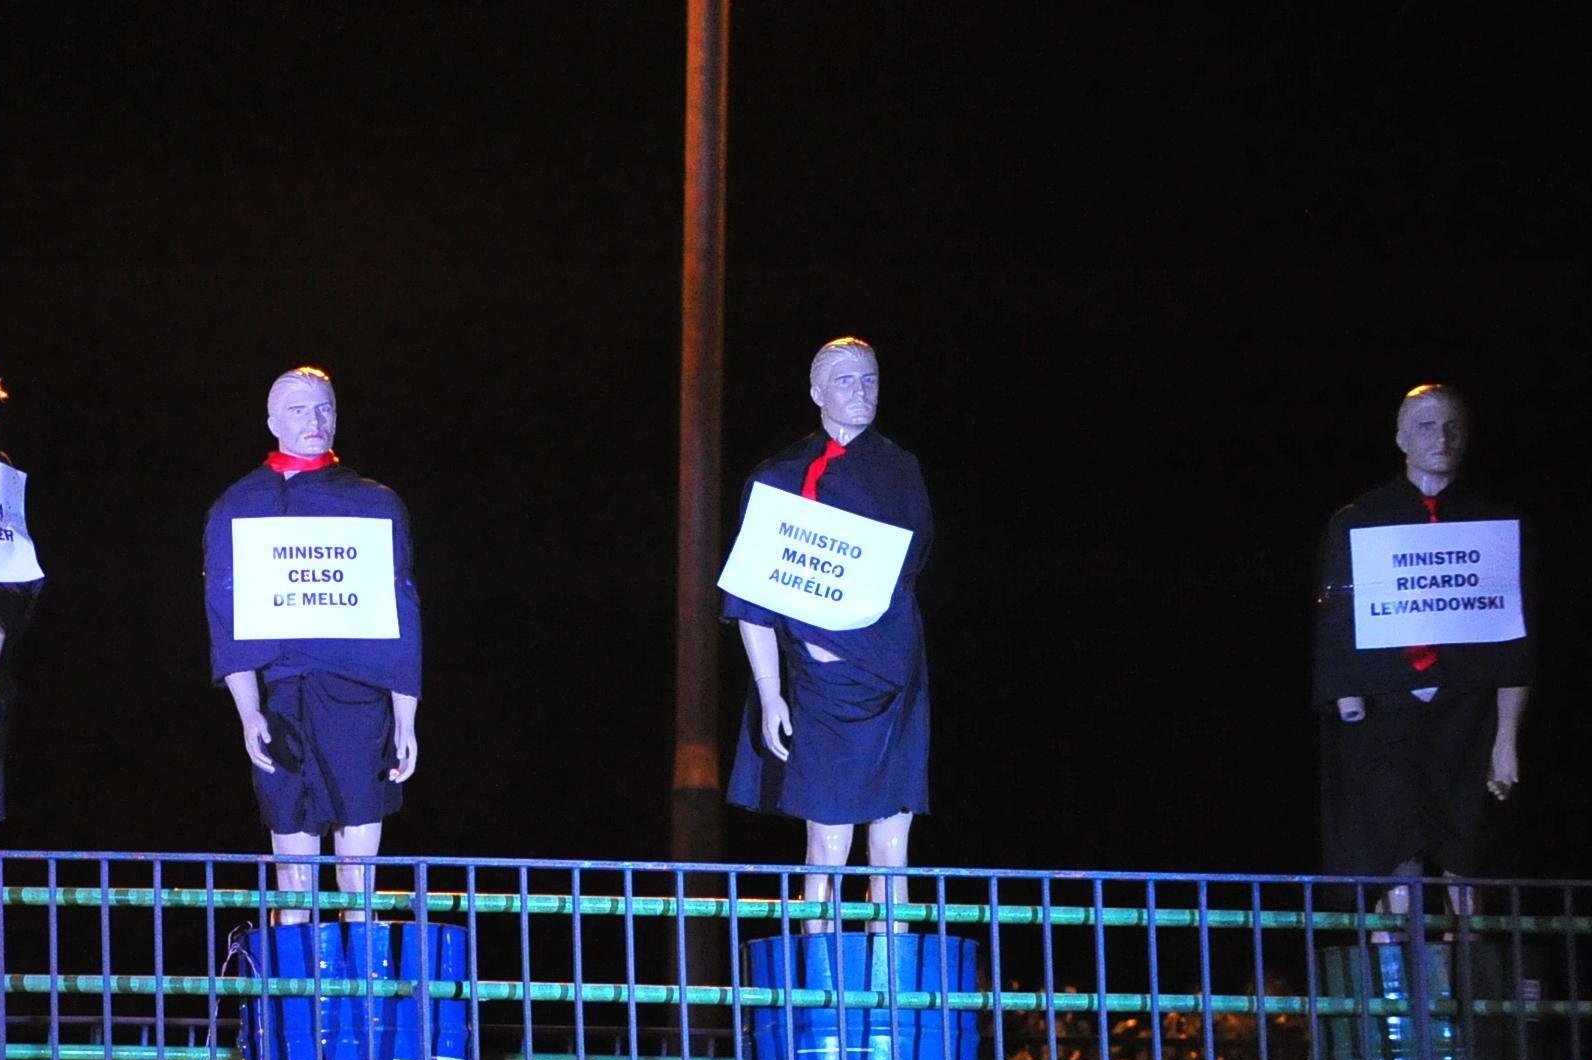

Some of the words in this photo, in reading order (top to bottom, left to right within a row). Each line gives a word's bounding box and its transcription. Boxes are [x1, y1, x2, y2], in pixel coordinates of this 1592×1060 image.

[778, 521, 863, 560] MINISTRO
[272, 546, 357, 560] MINISTRO
[781, 547, 845, 578] MARCO
[1392, 549, 1481, 568] MINISTRO
[288, 569, 344, 583] CELSO
[768, 567, 844, 602] AURÉLIO
[1396, 572, 1480, 591] RICARDO
[273, 592, 297, 607] DE
[302, 592, 358, 607] MELLO
[1370, 595, 1505, 616] LEWANDOWSKI
